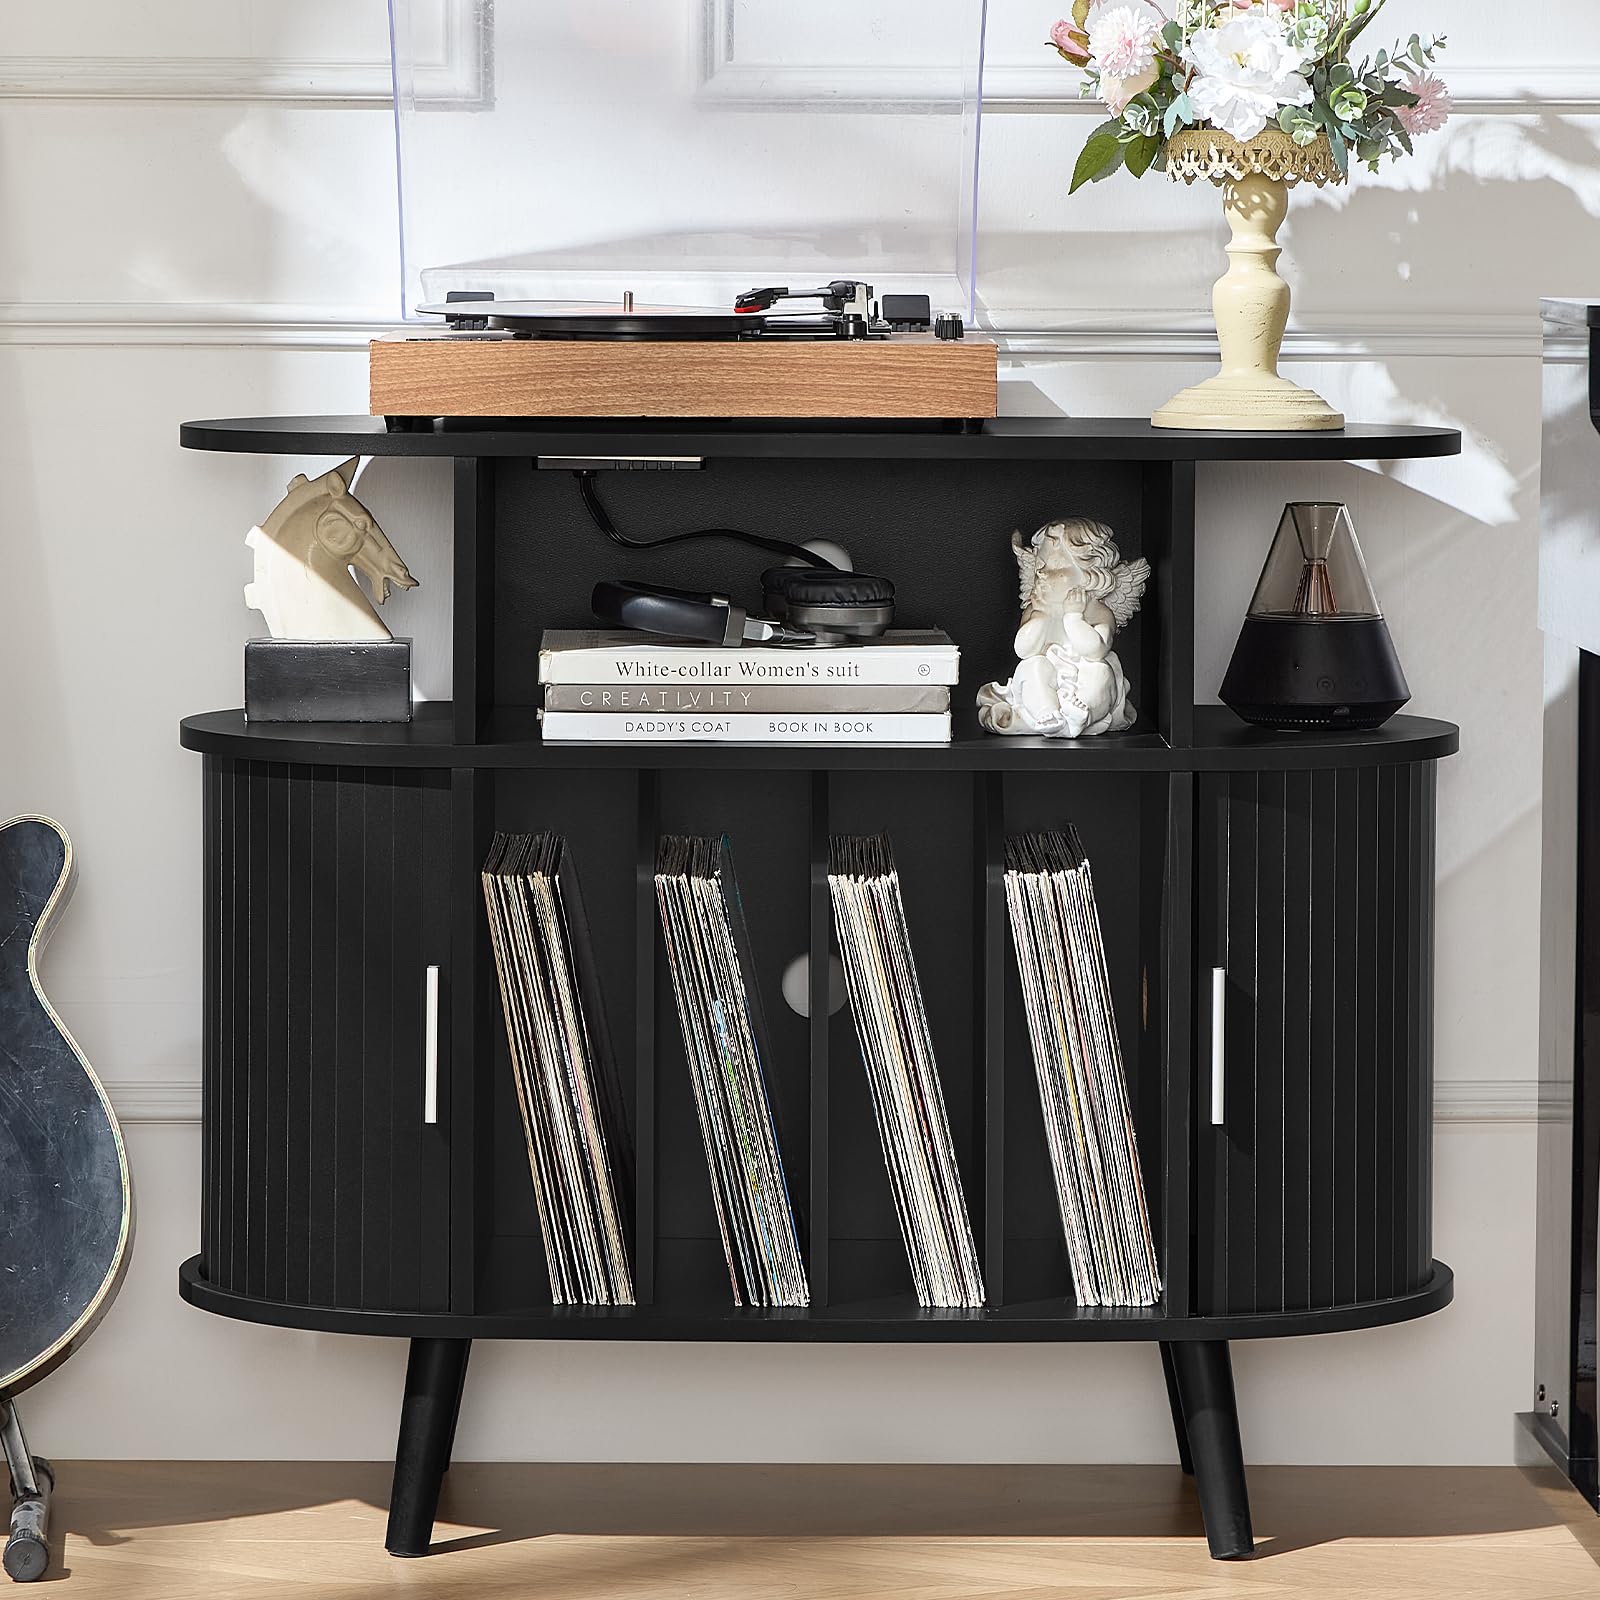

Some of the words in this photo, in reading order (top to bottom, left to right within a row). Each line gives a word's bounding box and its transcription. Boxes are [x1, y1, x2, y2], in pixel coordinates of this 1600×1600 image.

[615, 661, 732, 677] White-collar
[738, 661, 819, 677] Women's
[827, 661, 860, 677] suit
[580, 691, 752, 706] CREATIVITY
[624, 721, 686, 733] DADDY'S
[691, 721, 731, 733] COAT
[769, 721, 809, 733] BOOK
[814, 721, 828, 733] IN
[834, 721, 873, 733] BOOK
